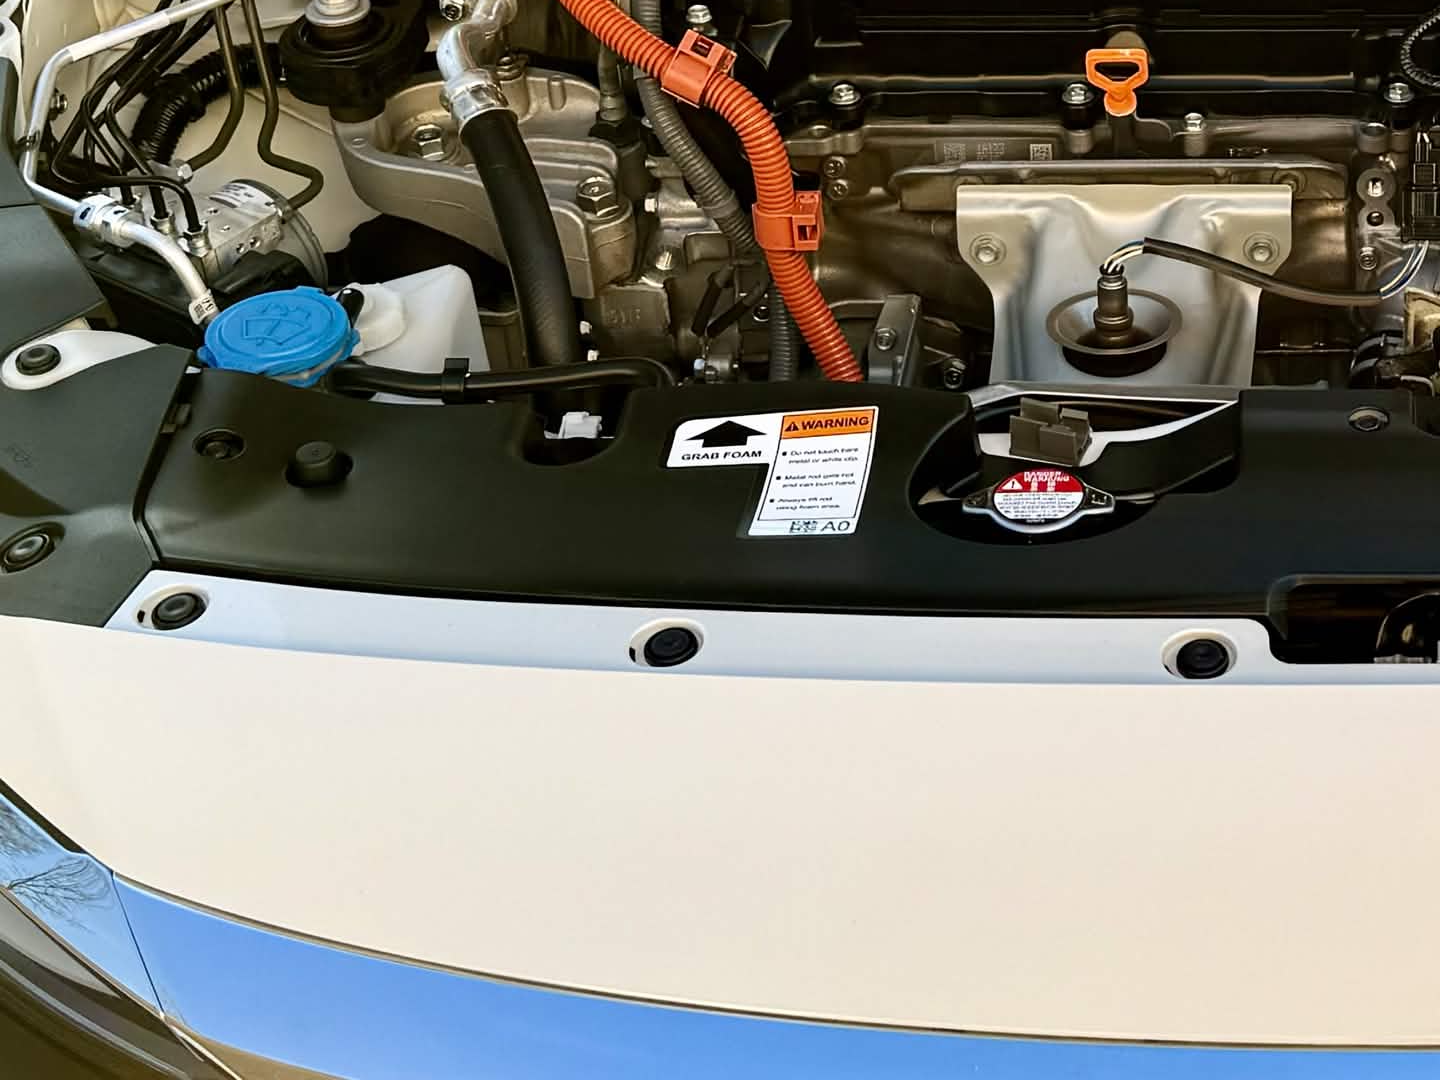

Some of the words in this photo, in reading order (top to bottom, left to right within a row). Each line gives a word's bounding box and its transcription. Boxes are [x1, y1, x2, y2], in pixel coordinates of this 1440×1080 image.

[801, 416, 869, 431] WARNING
[681, 453, 720, 461] GRAB
[723, 450, 762, 459] FOAM
